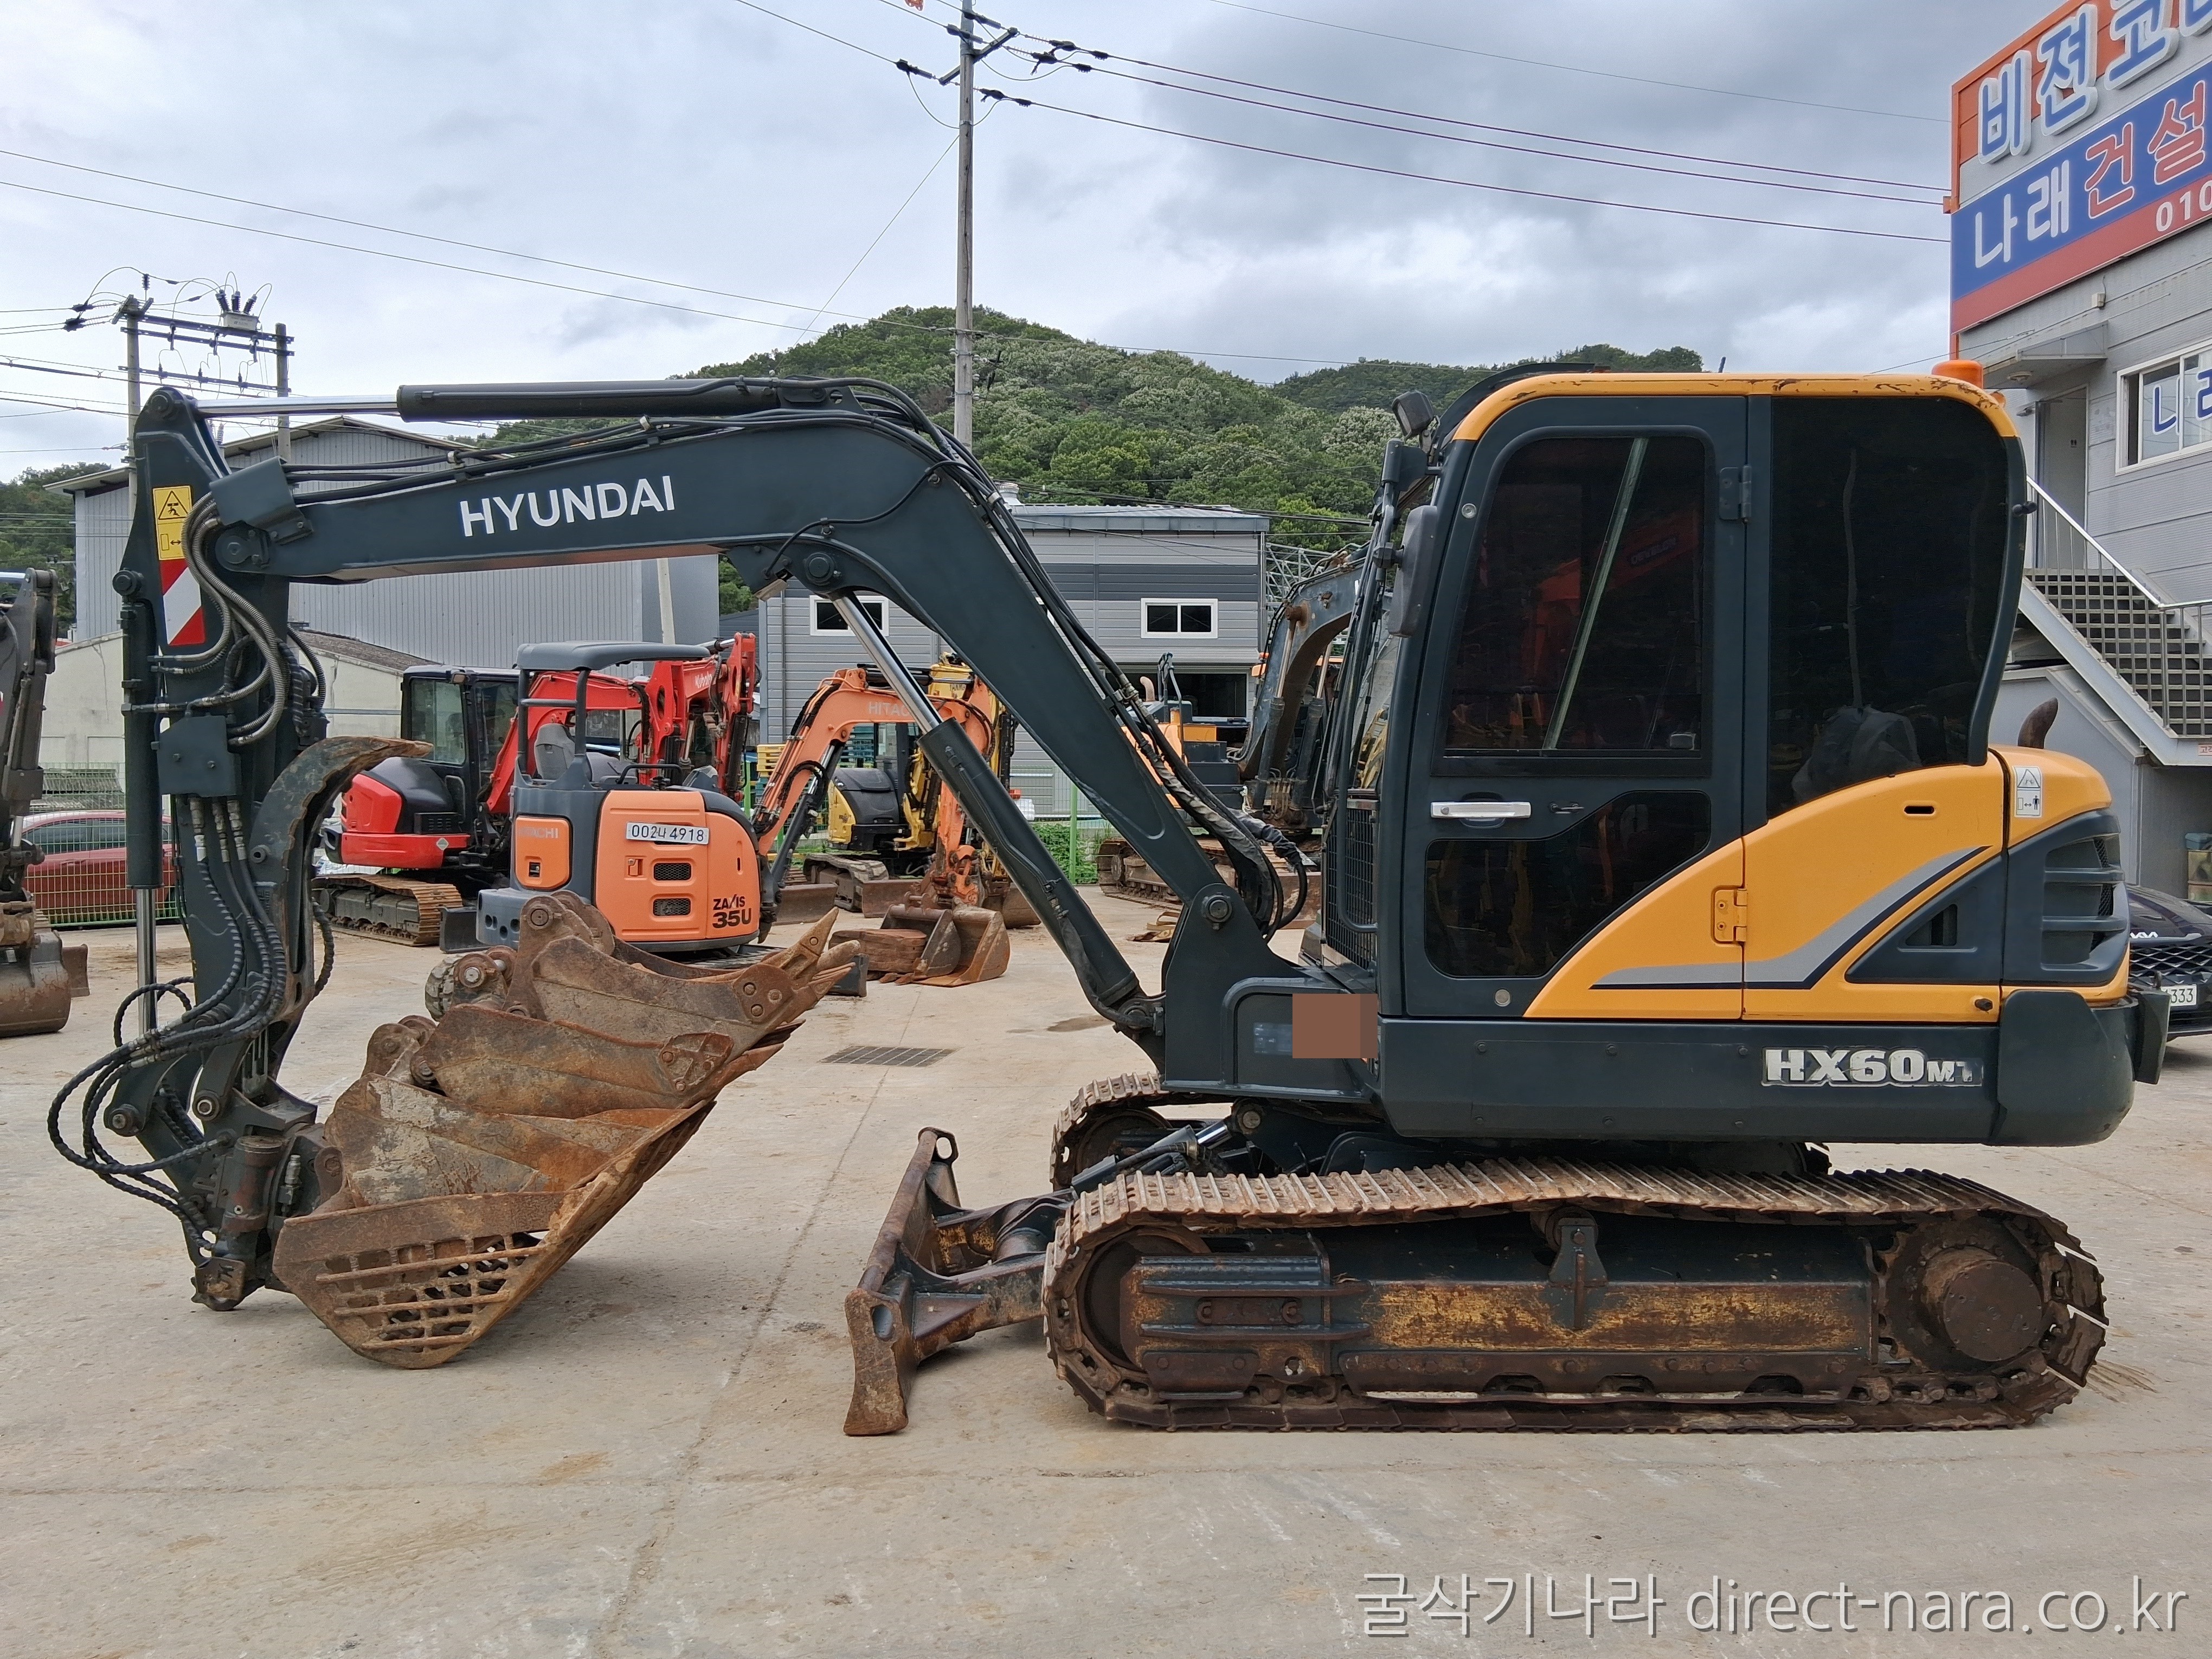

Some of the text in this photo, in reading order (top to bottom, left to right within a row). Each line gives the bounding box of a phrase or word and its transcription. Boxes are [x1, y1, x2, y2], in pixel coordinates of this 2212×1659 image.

[460, 475, 675, 537] HYUNDAI
[518, 826, 558, 839] ACHI
[670, 827, 704, 842] 4918
[712, 908, 752, 929] 35U
